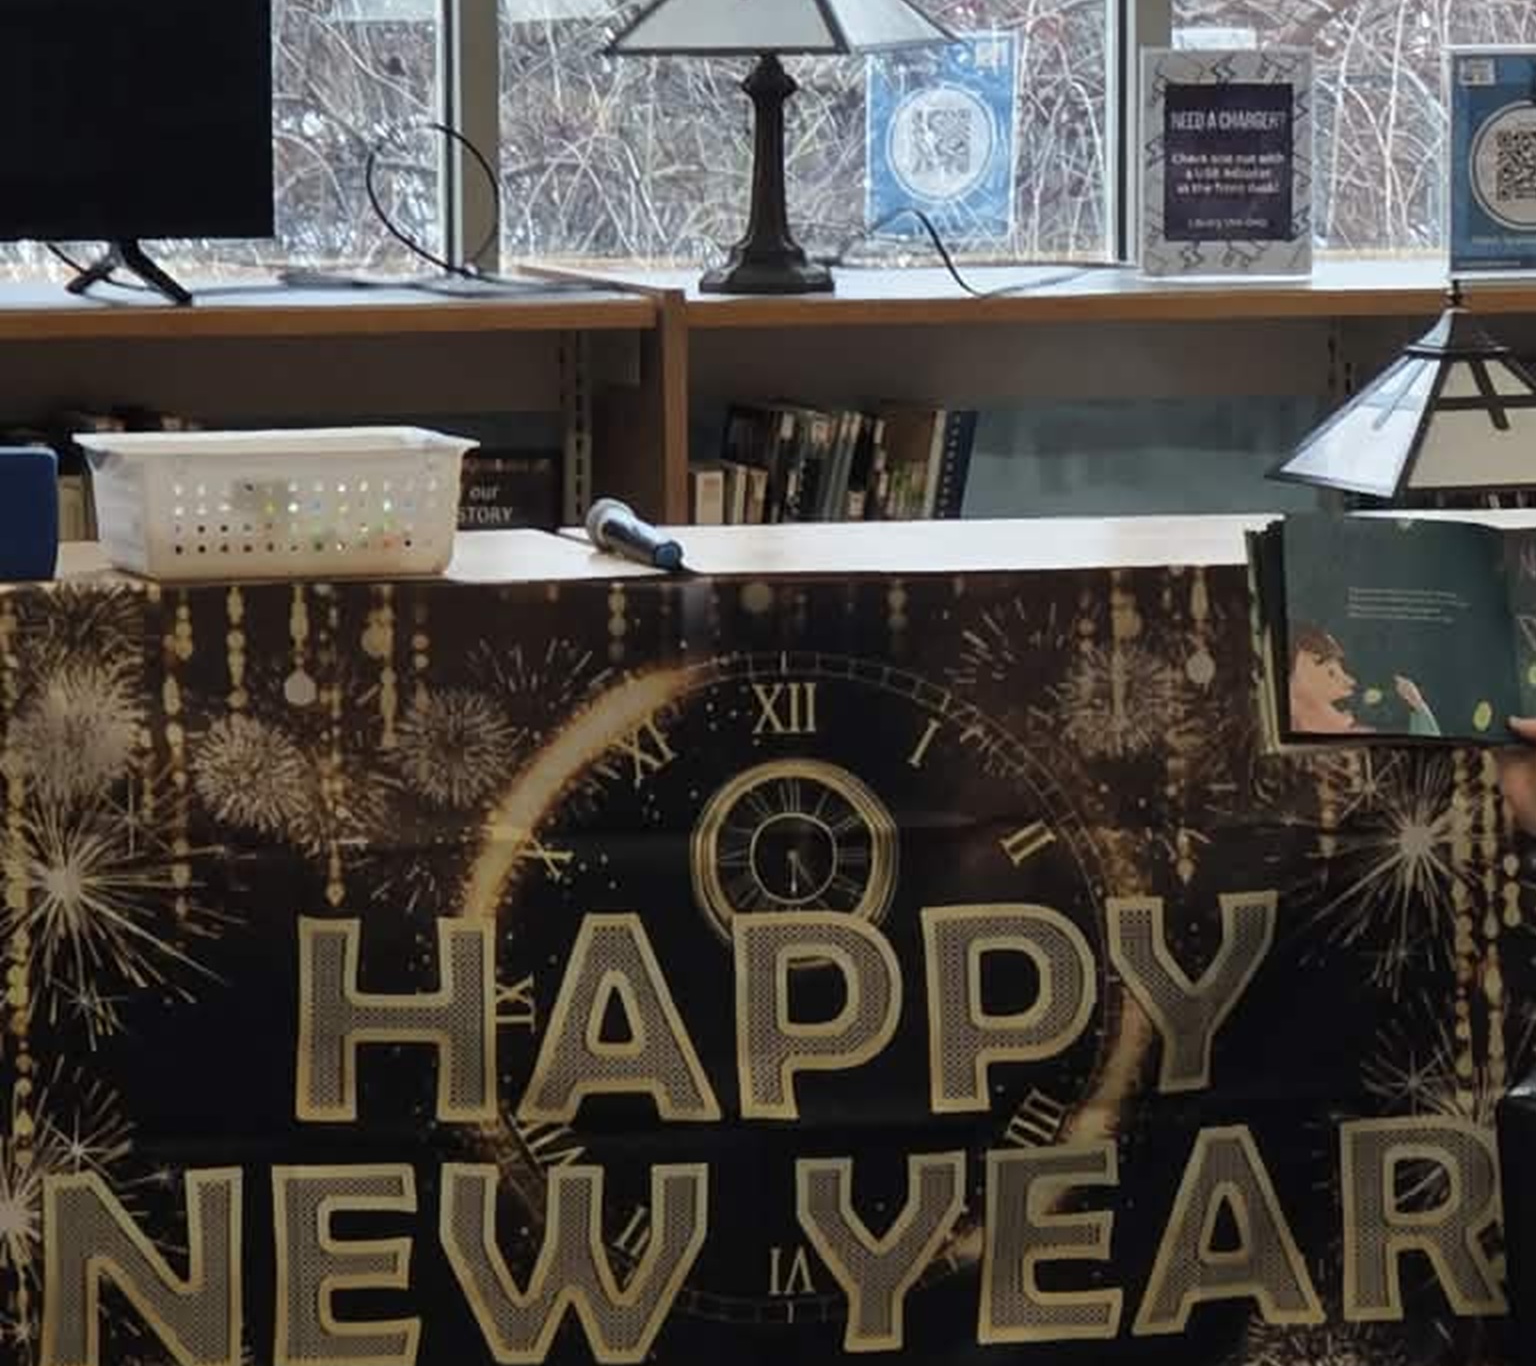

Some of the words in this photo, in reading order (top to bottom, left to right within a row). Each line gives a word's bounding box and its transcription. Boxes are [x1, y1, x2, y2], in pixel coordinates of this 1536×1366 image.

[1171, 110, 1204, 131] NEED
[1206, 110, 1216, 131] A
[751, 682, 818, 734] XII
[295, 890, 1278, 1123] HAPPY
[796, 1113, 1509, 1354] YEAR
